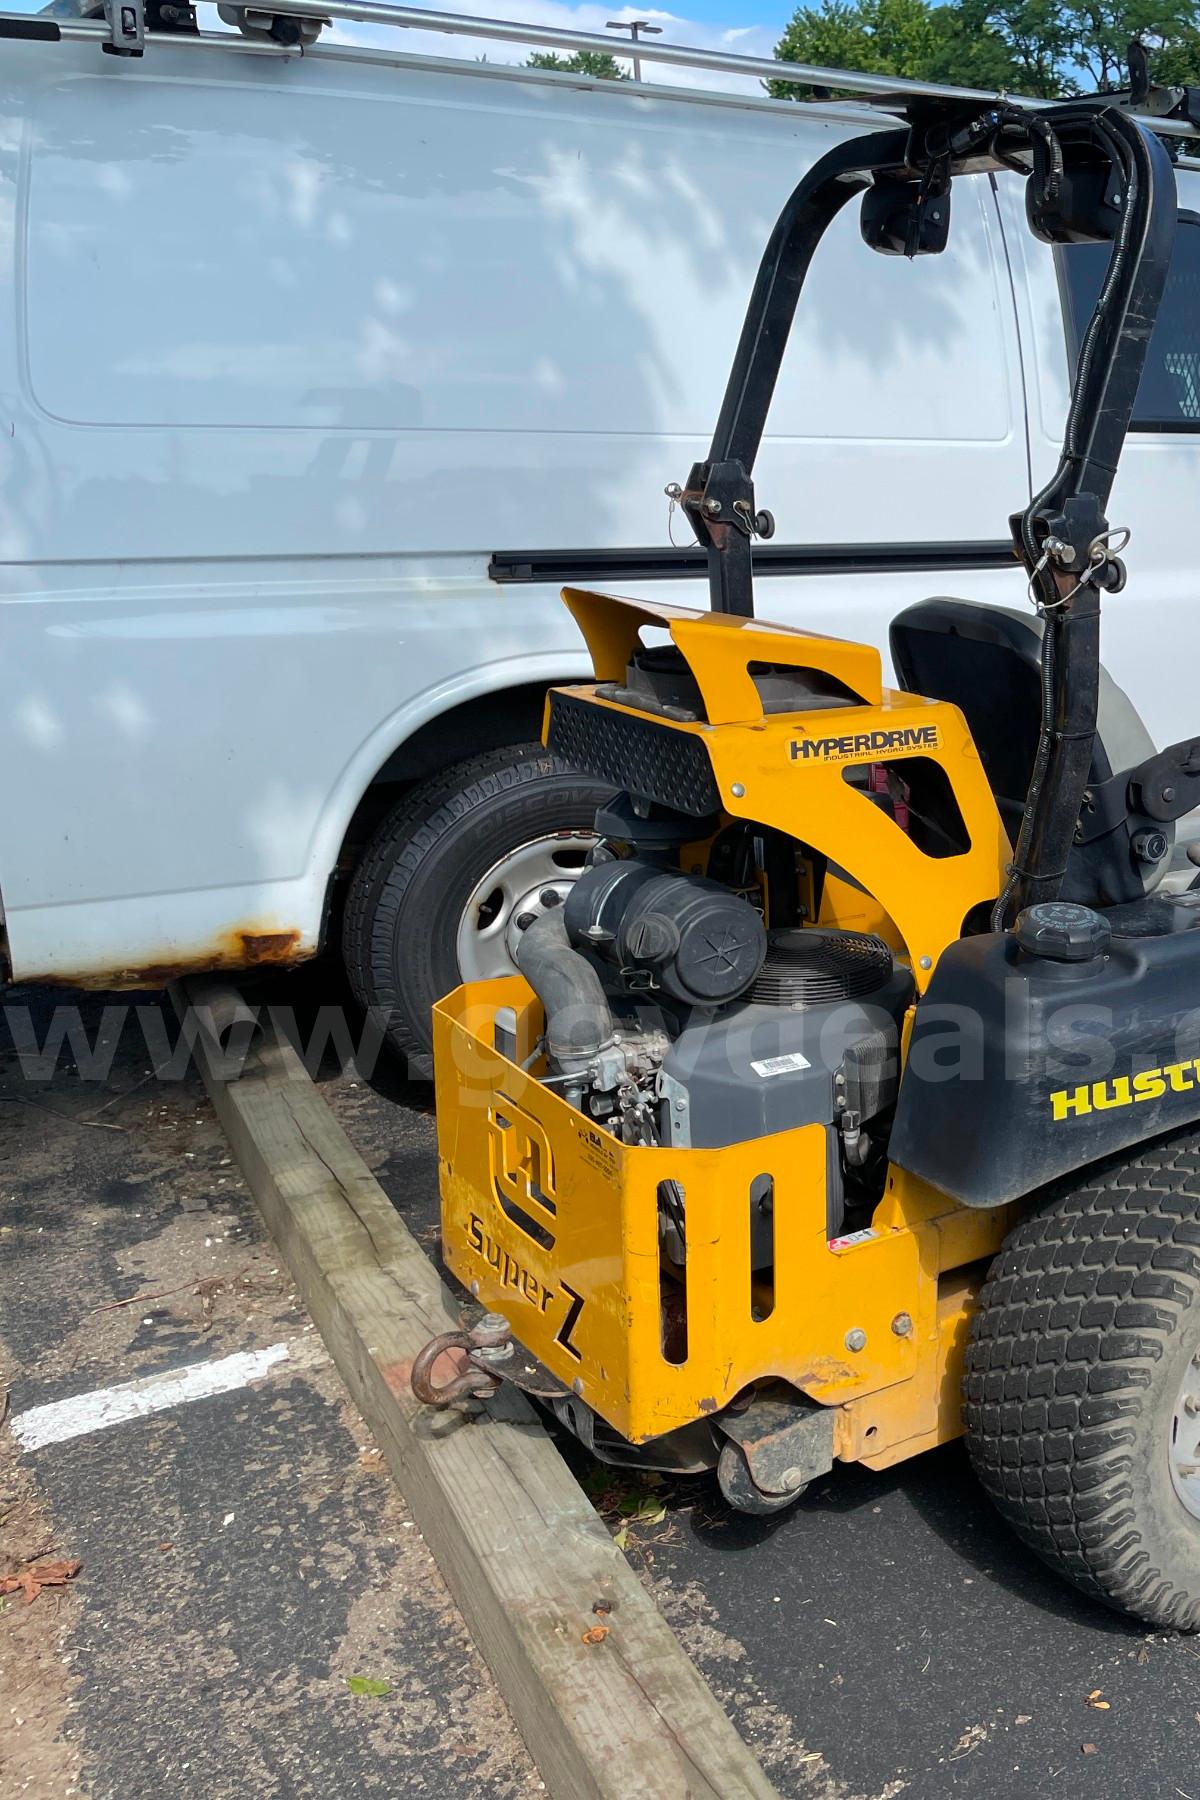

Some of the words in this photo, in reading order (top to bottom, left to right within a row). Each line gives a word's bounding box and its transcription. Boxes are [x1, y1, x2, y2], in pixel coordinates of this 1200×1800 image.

[790, 725, 938, 760] HYPERDRIVE
[823, 751, 873, 762] INDUSTRIAL
[876, 746, 904, 757] HYDRO
[464, 1211, 554, 1317] Super
[553, 1278, 586, 1364] Z
